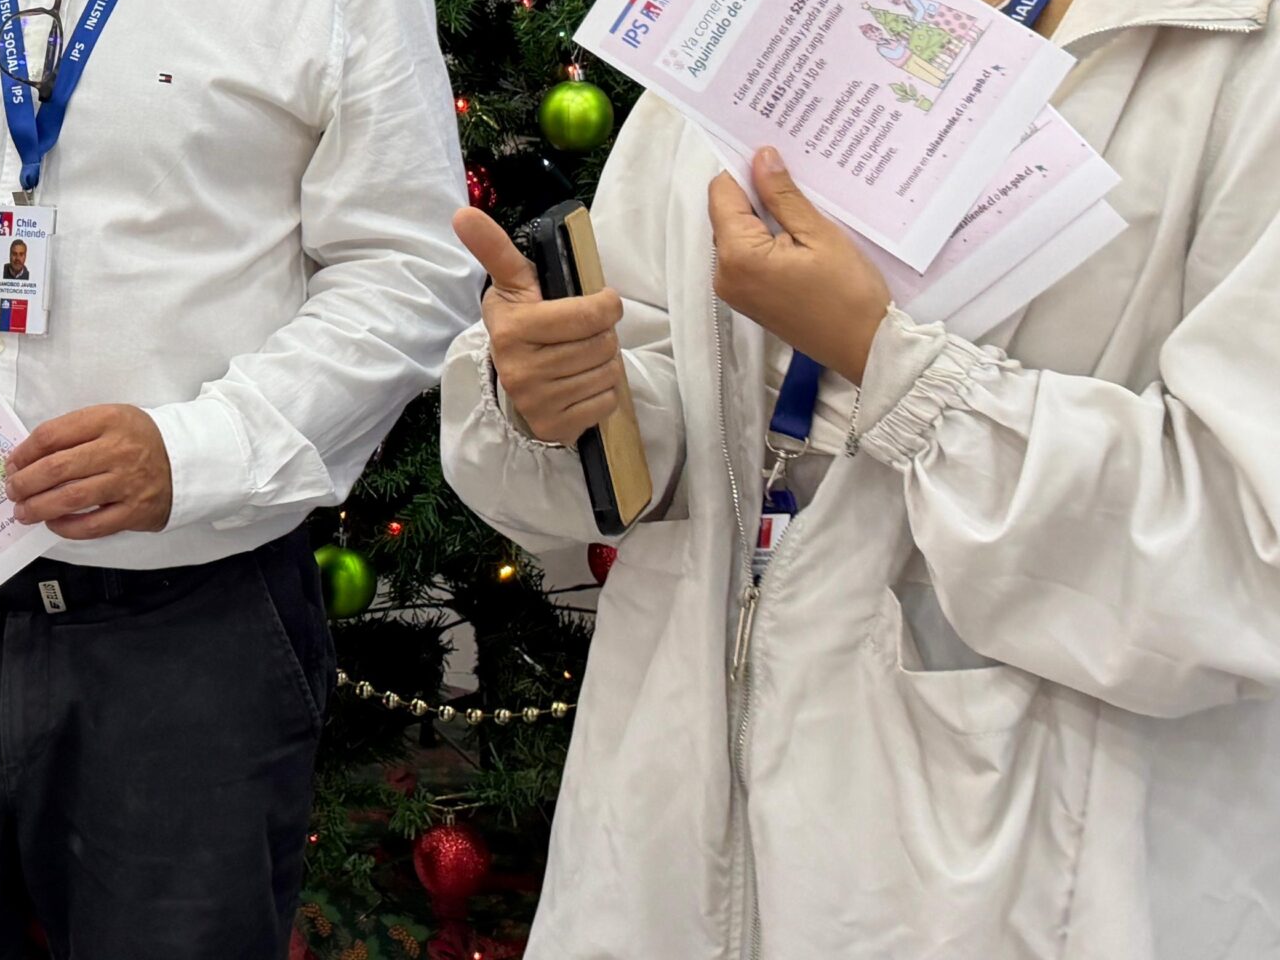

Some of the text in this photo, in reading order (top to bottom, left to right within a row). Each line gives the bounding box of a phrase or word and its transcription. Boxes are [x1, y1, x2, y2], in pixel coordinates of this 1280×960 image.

[622, 19, 650, 49] IPS
[682, 35, 700, 57] ¡Ya
[687, 17, 731, 78] Aguinaldo
[726, 0, 743, 18] de
[69, 42, 85, 62] IPS
[3, 32, 19, 73] SOCIAL
[11, 86, 23, 103] IPS
[16, 218, 37, 228] Chile
